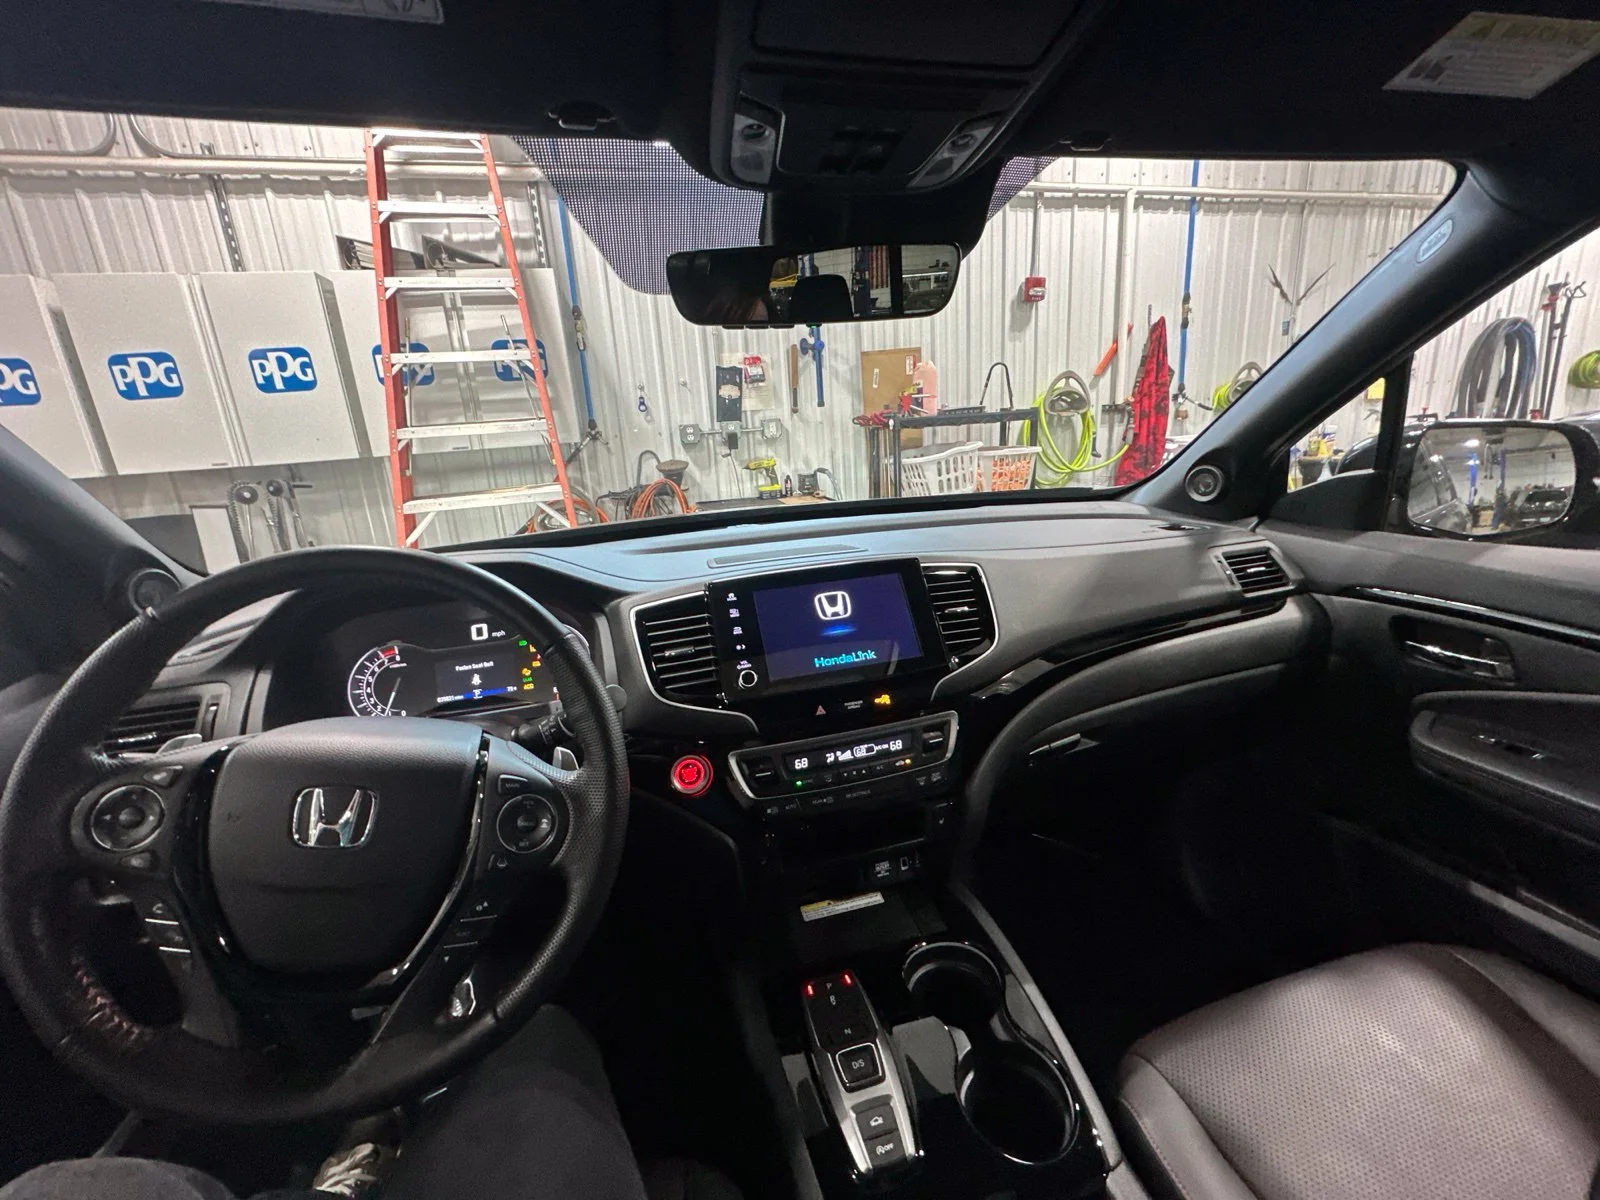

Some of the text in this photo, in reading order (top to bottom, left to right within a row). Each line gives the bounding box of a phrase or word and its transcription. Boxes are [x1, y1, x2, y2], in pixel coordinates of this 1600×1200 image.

[111, 356, 181, 397] PPG
[252, 351, 315, 390] PPG
[471, 623, 506, 640] 0 mph
[814, 649, 877, 668] HondaLink
[889, 739, 903, 751] 68
[794, 757, 809, 770] 68
[851, 1059, 865, 1069] D/S
